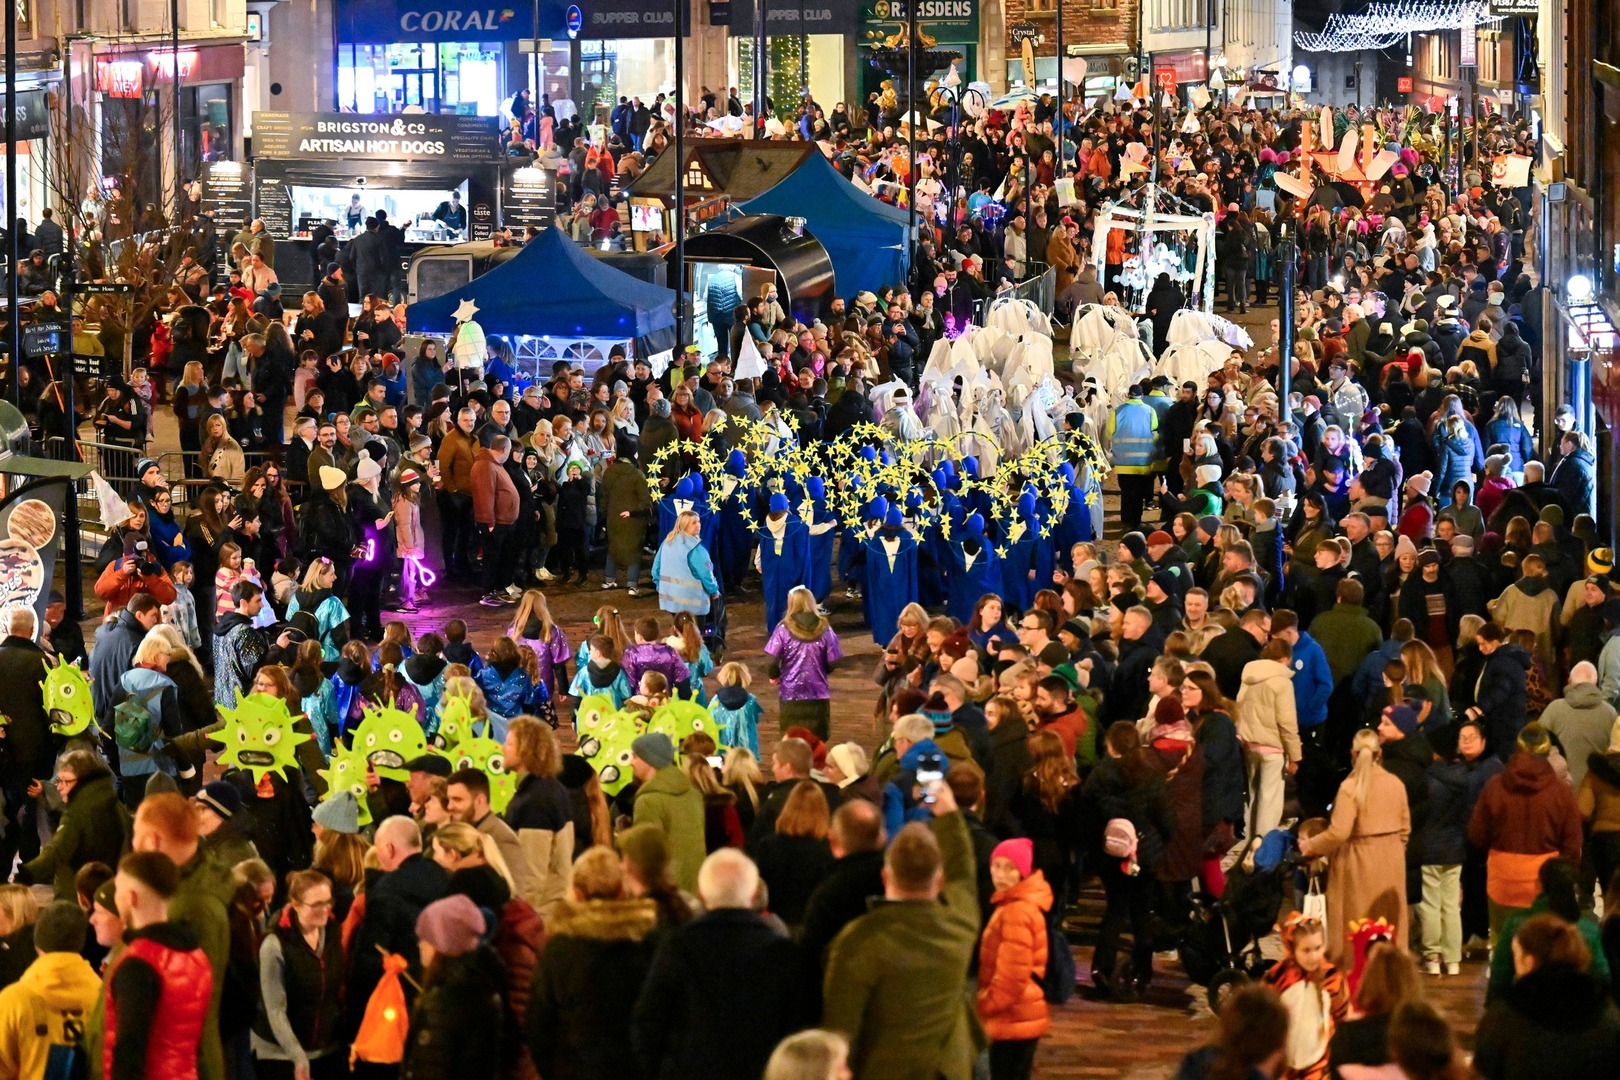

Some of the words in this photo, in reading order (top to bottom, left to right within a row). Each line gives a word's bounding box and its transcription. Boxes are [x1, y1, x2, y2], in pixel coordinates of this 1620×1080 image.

[803, 9, 832, 20] CLUB
[891, 1, 972, 17] RSDENS
[400, 10, 499, 32] CORAL
[592, 12, 640, 24] SUPPER
[643, 11, 674, 24] CLUB
[1012, 28, 1035, 38] Crystal
[299, 138, 364, 153] ARTISAN
[366, 140, 399, 154] HOT
[401, 140, 445, 155] DOGS
